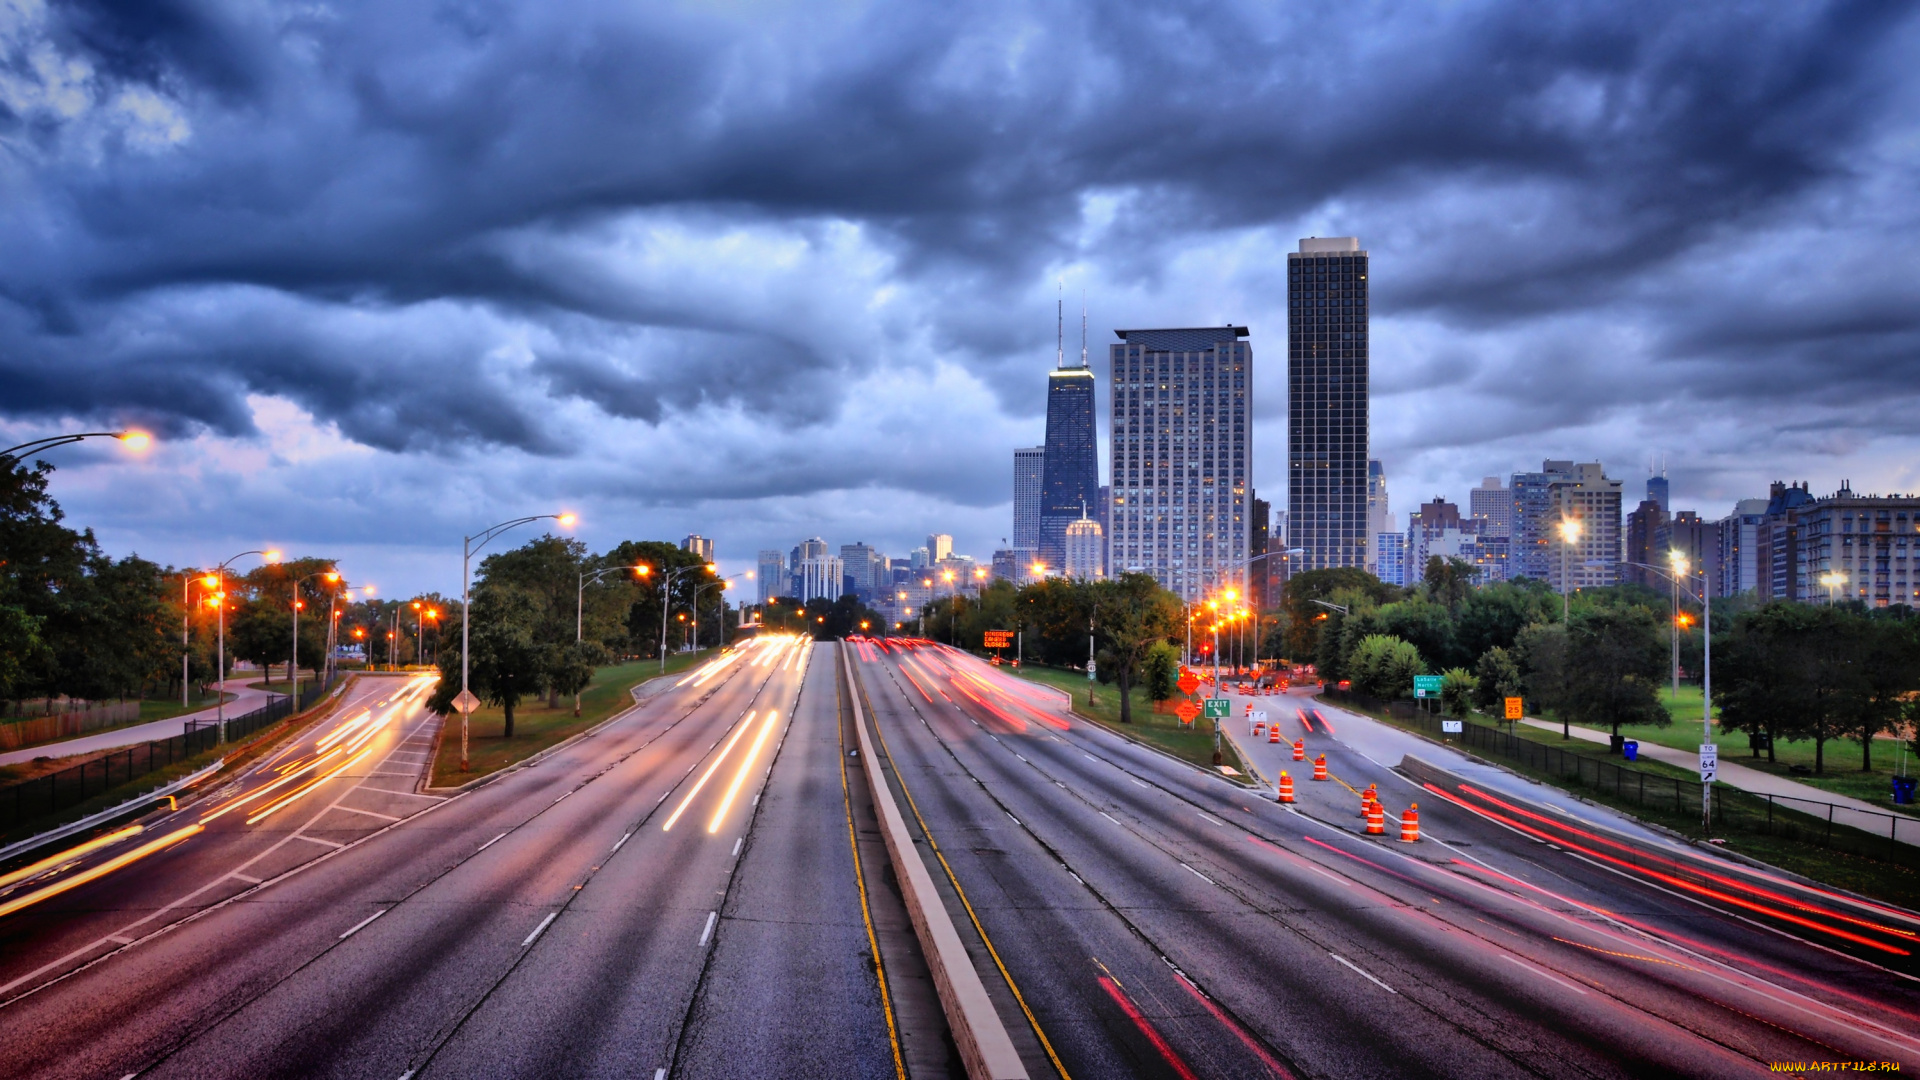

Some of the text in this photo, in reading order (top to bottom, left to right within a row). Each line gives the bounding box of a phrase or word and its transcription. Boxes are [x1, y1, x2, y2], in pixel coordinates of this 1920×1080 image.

[1207, 700, 1228, 708] EXIT
[1508, 706, 1519, 714] 25
[1702, 760, 1715, 769] 64
